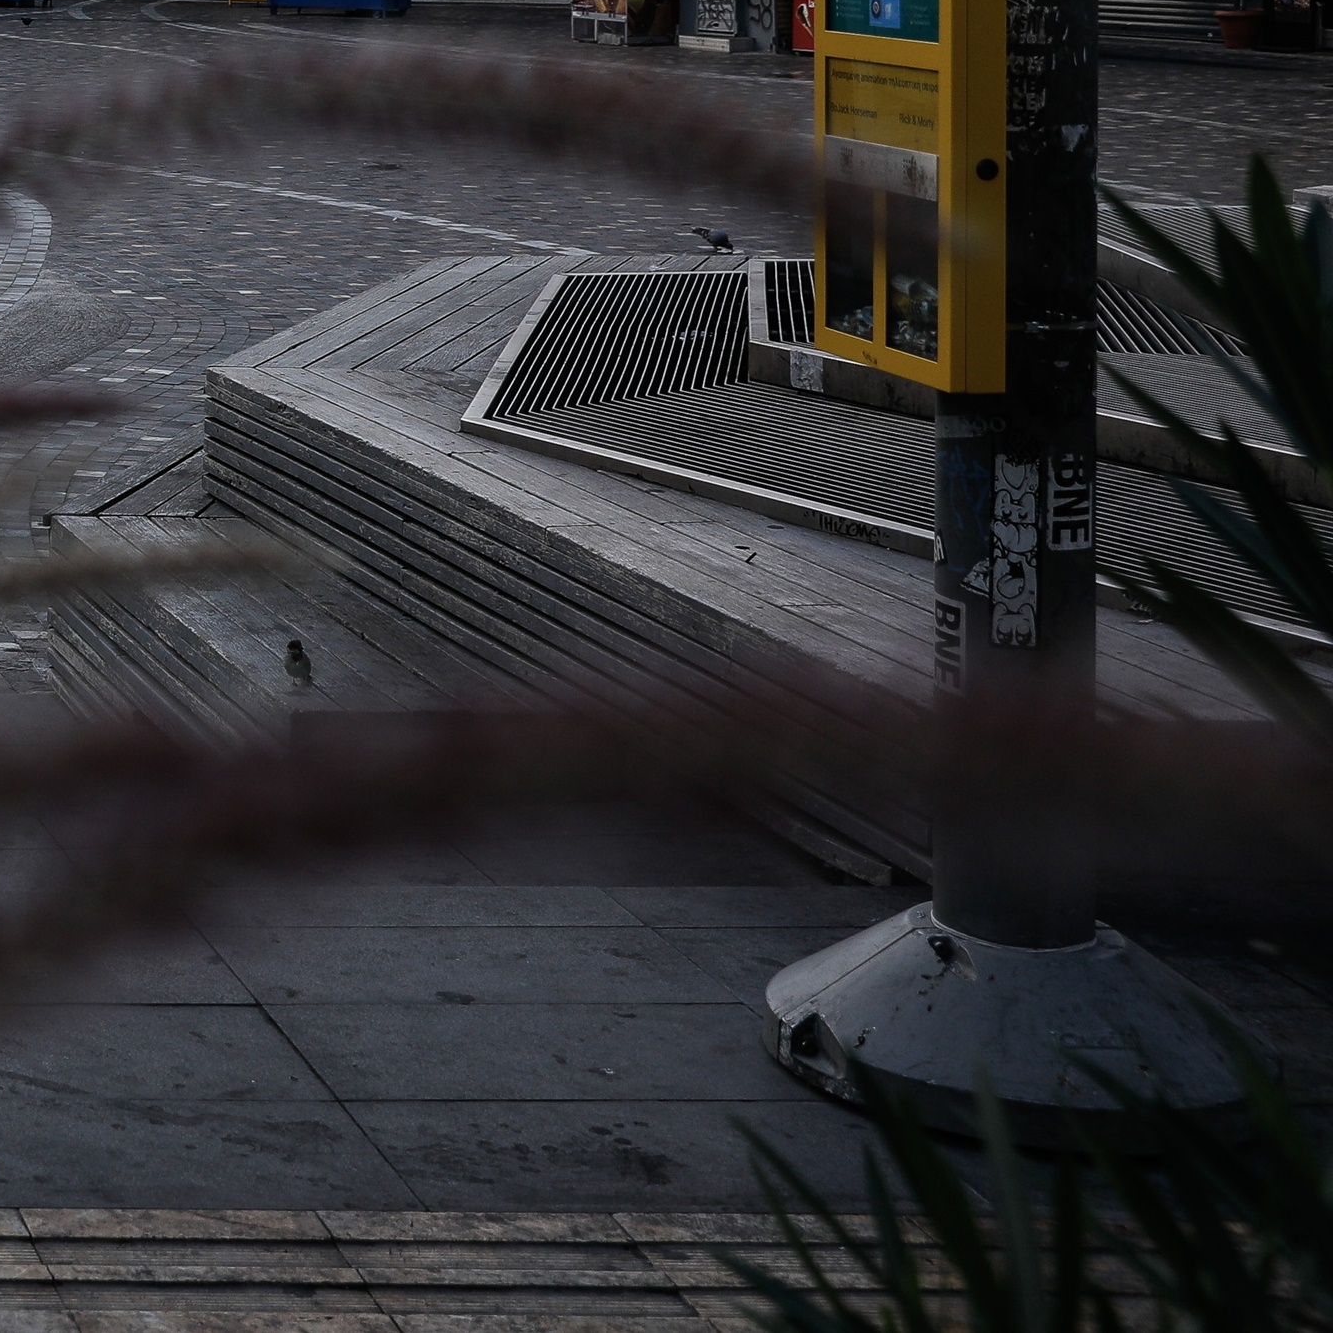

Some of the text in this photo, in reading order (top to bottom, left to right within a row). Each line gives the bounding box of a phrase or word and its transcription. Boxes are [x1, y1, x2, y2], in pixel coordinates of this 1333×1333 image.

[861, 73, 888, 86] animation
[830, 102, 878, 119] BoJack Horseman
[911, 115, 917, 125] &
[917, 116, 935, 130] Morty
[935, 599, 961, 689] BNE
